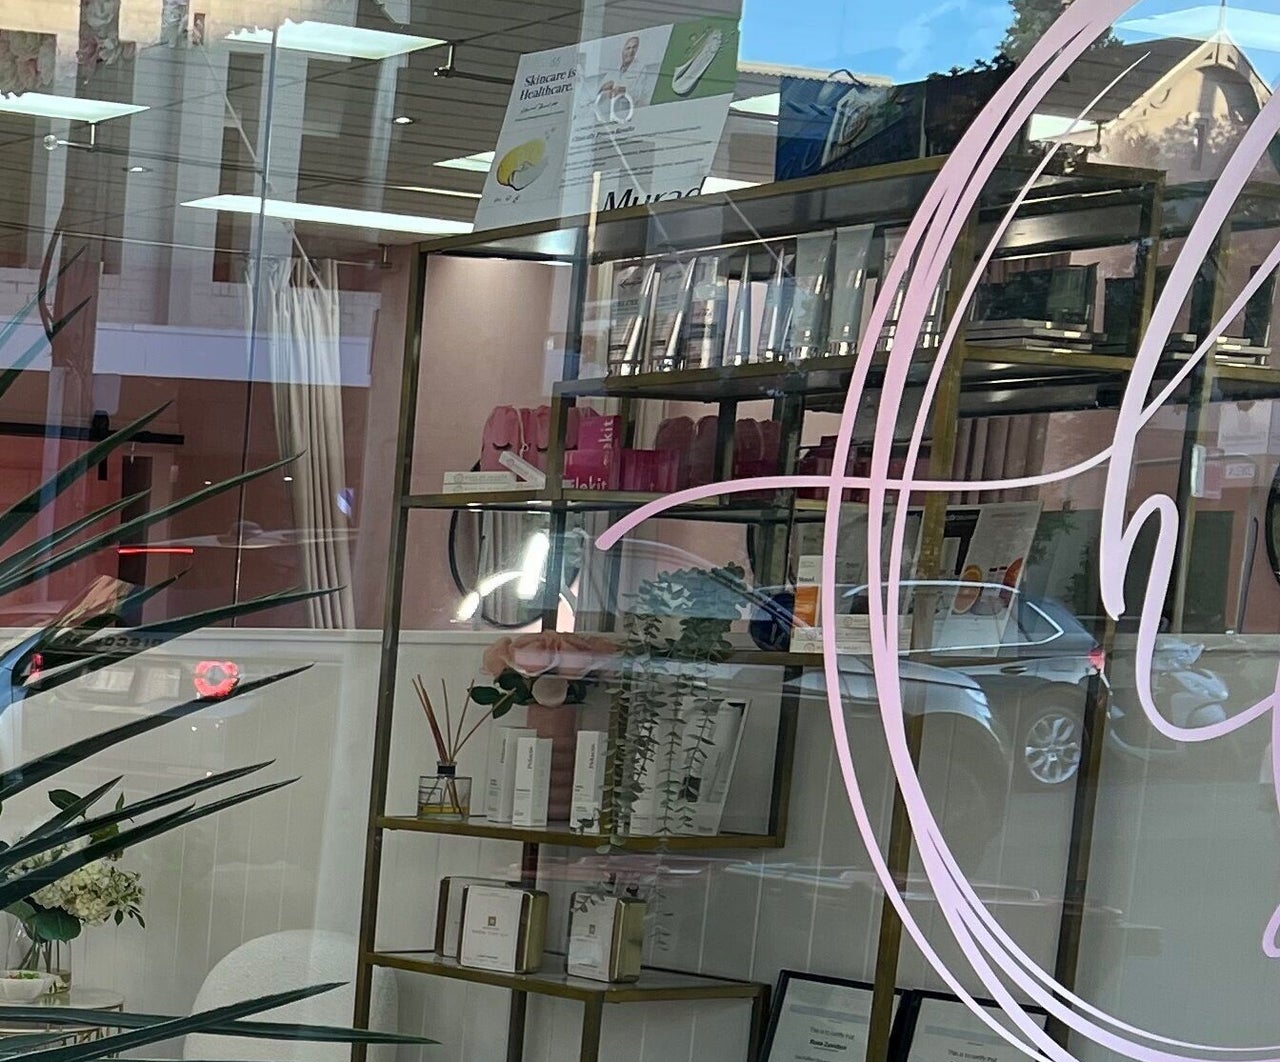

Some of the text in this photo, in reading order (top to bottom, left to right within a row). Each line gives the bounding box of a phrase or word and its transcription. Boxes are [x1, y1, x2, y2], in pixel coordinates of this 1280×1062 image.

[524, 67, 577, 88] Skincare is
[520, 83, 573, 101] Healthcare.
